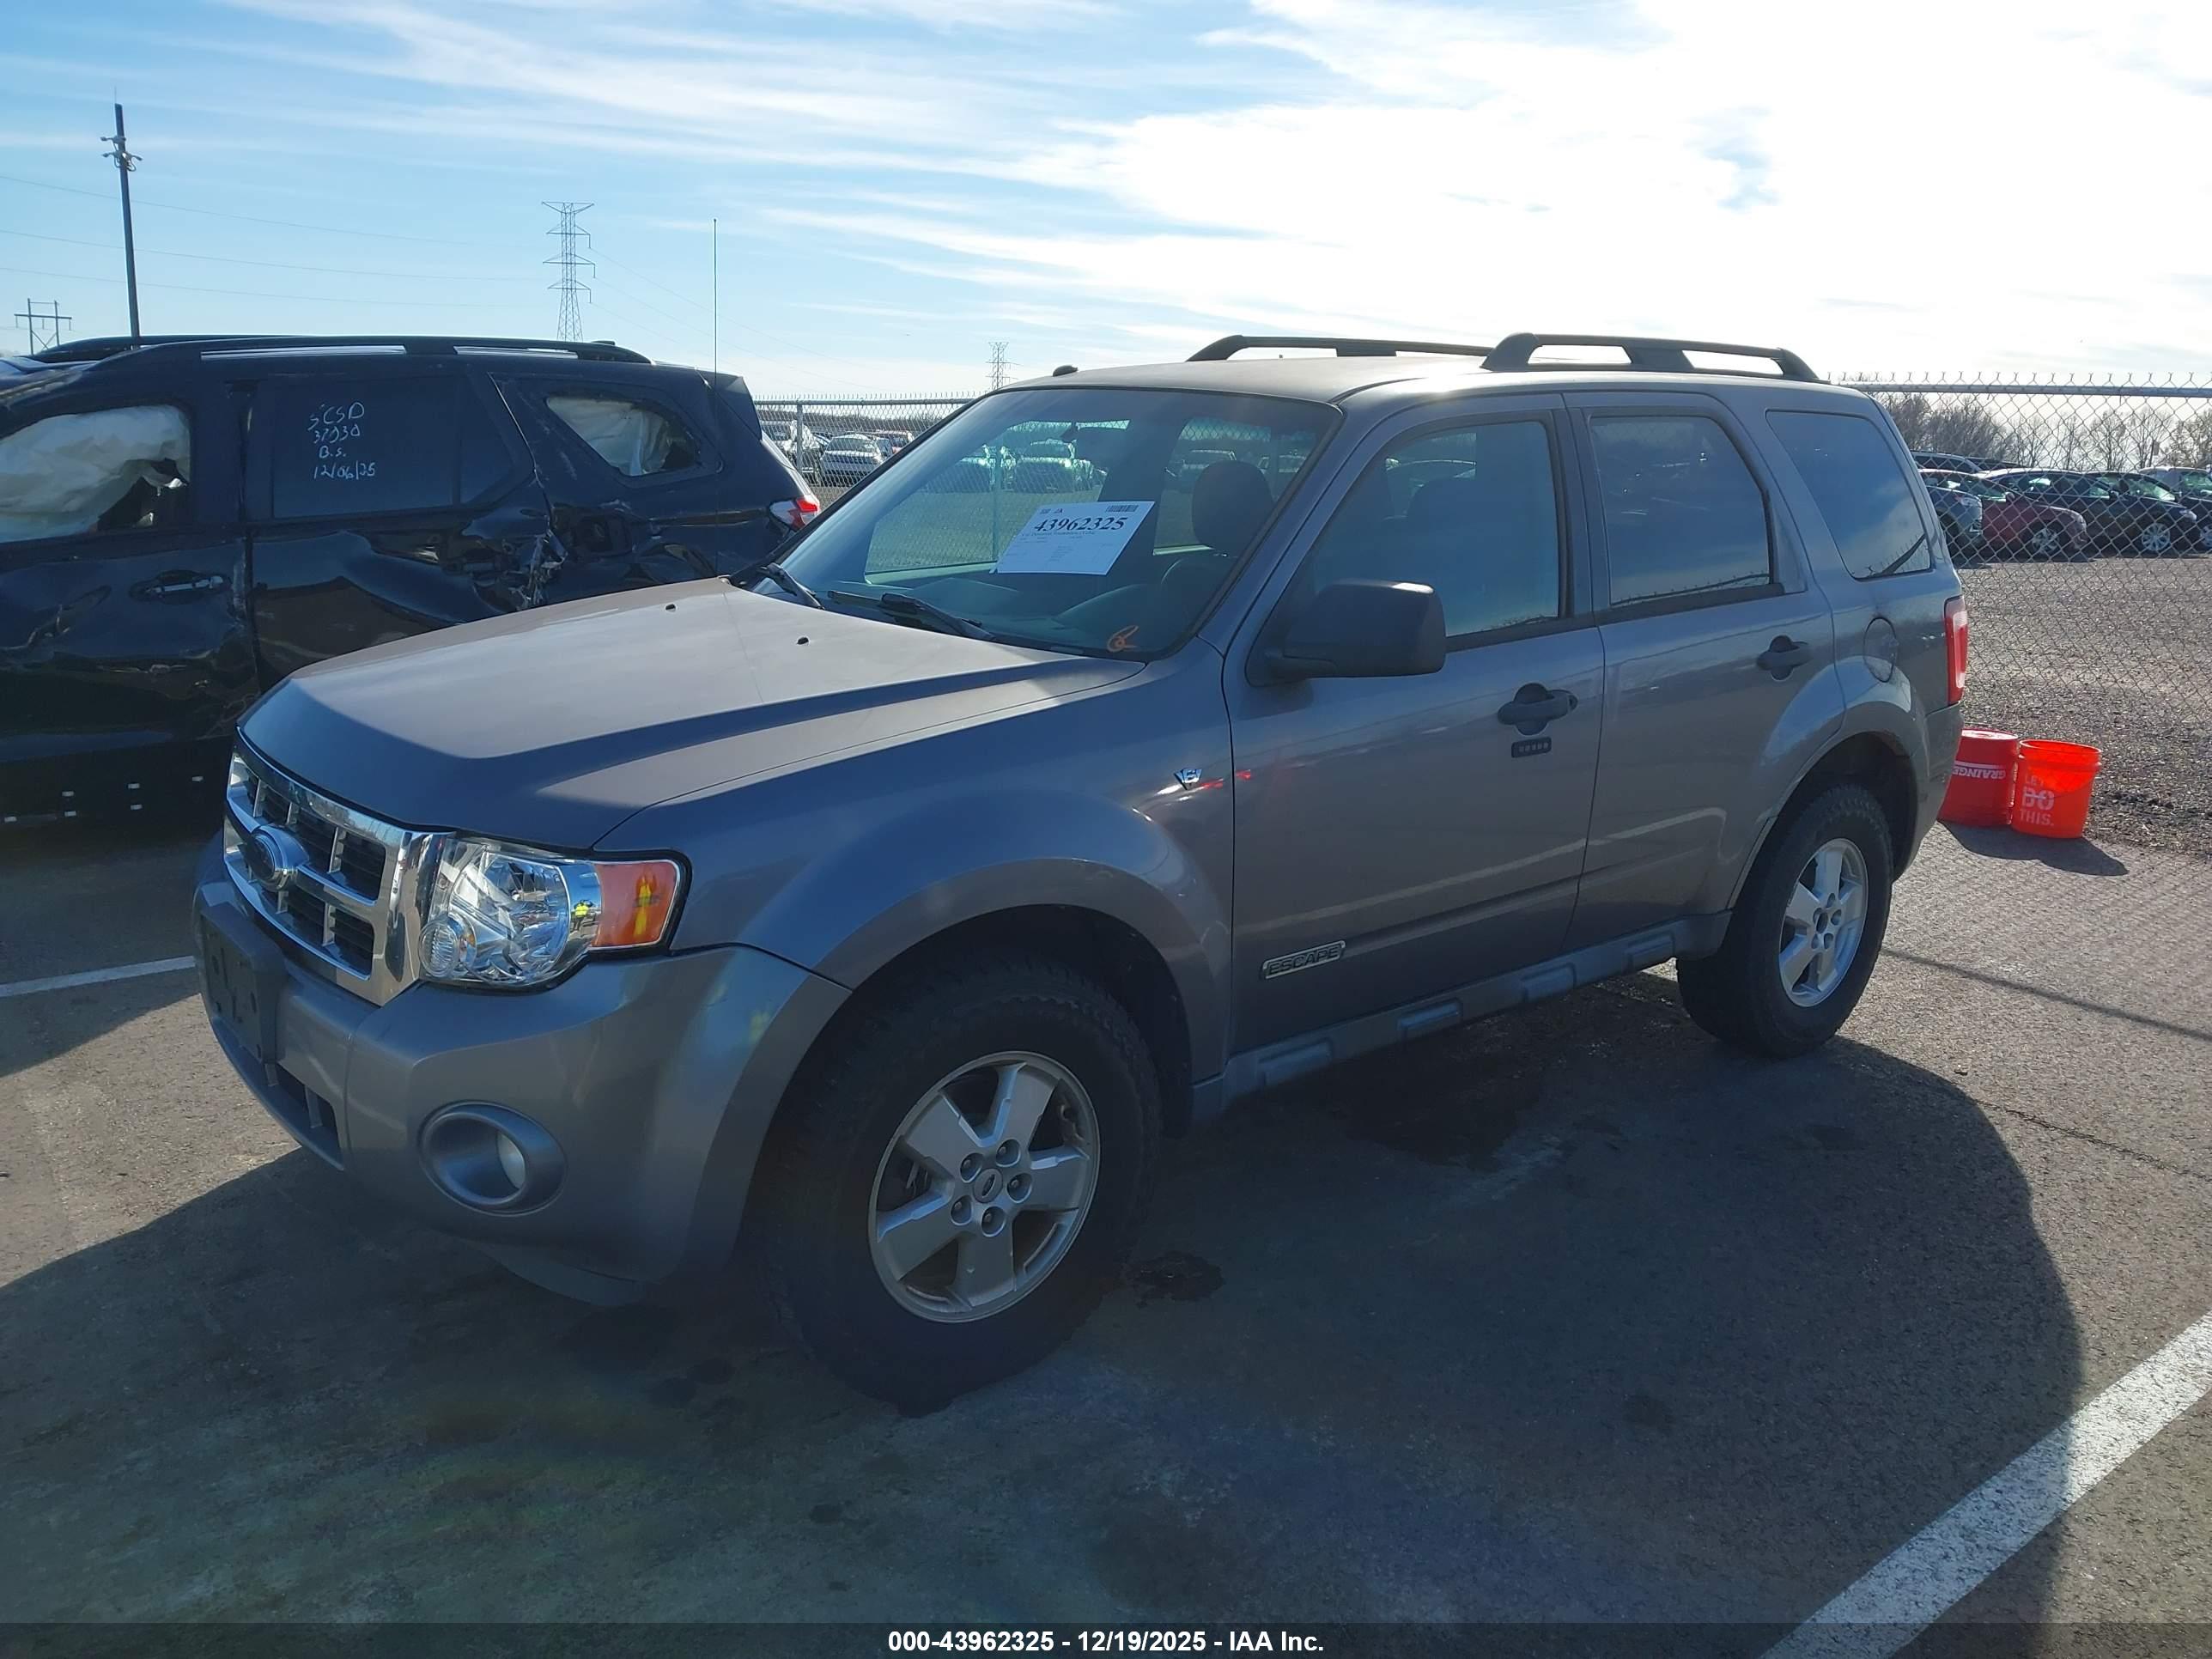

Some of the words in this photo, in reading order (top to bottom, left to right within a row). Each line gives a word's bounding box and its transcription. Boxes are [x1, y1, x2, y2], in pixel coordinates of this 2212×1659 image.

[1034, 516, 1128, 532] 43962325
[2021, 786, 2055, 811] DO
[2019, 809, 2055, 827] THIS.
[1267, 945, 1341, 975] ESCAPE
